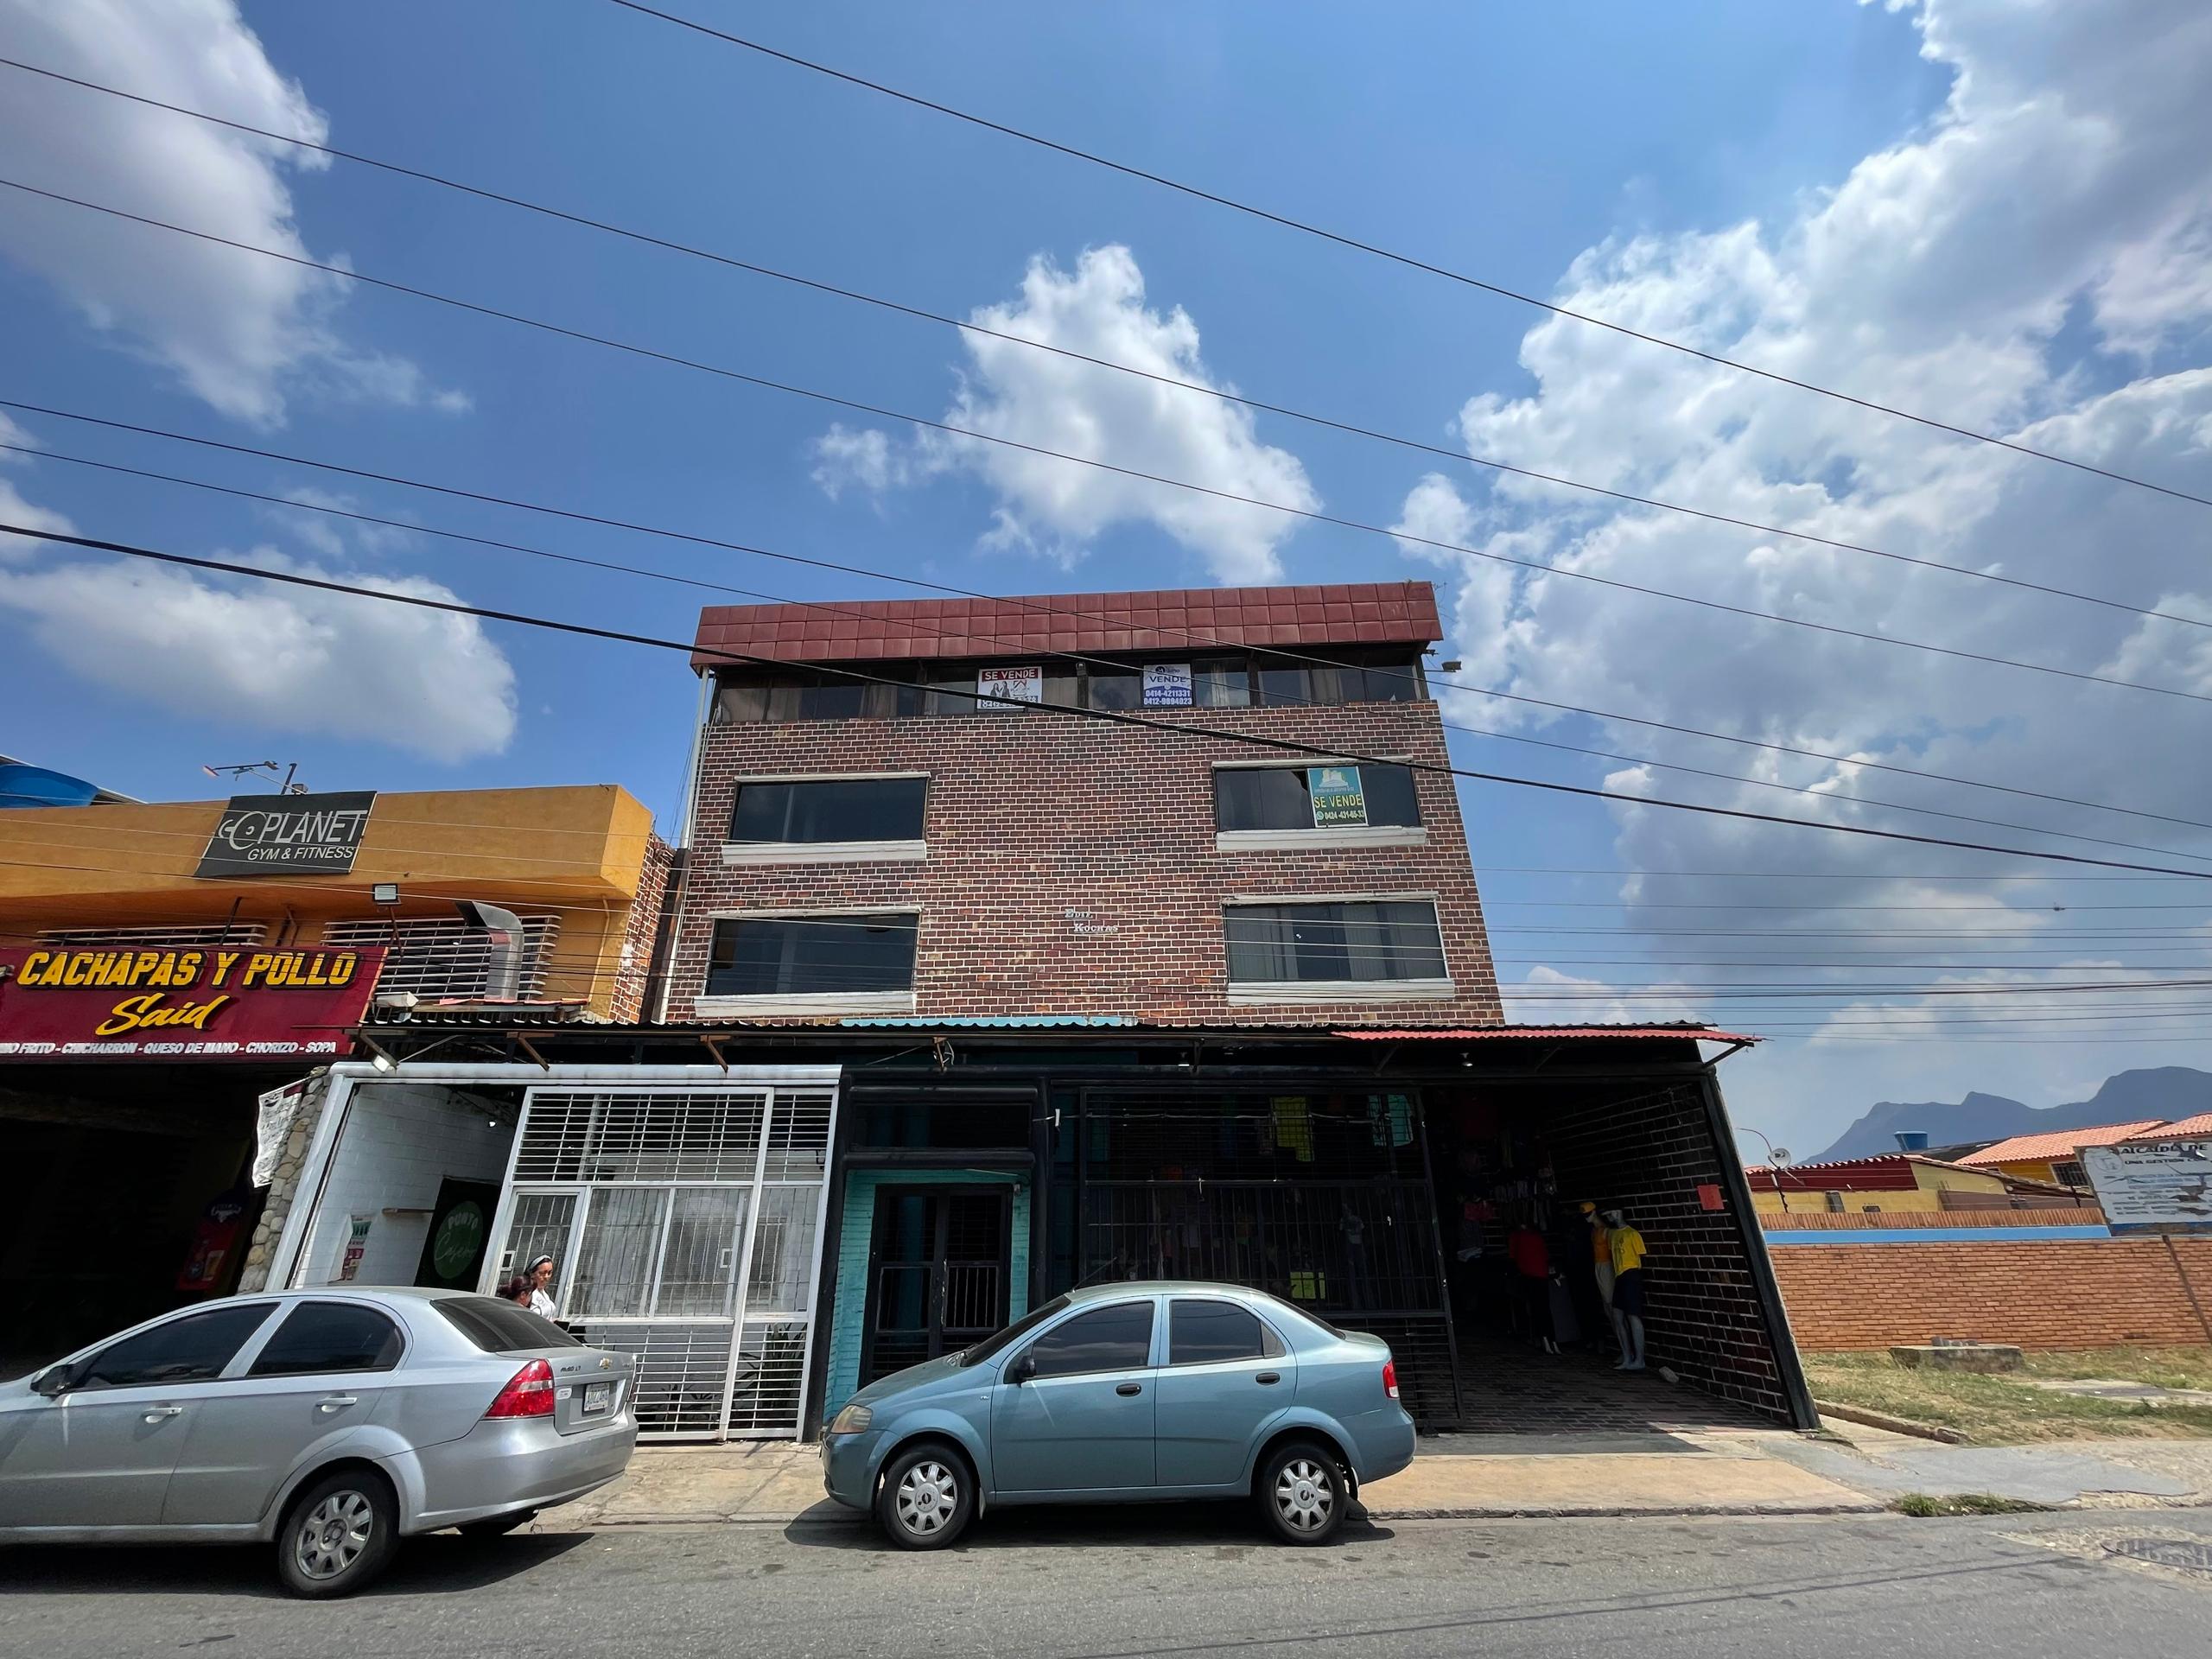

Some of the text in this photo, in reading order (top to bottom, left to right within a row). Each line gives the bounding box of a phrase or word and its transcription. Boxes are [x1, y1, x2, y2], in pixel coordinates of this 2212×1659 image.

[984, 668, 1036, 681] SE VENDE
[1313, 793, 1363, 809] SE VENDE
[247, 846, 354, 861] GYM & FITNESS
[16, 951, 358, 986] CACHAPAS Y POLLO
[95, 992, 231, 1036] Said
[17, 1042, 56, 1054] FRITO
[143, 1042, 185, 1054] QUESO
[184, 1042, 204, 1054] DE
[245, 1041, 299, 1053] CHORIZO
[305, 1041, 337, 1053] SOPA
